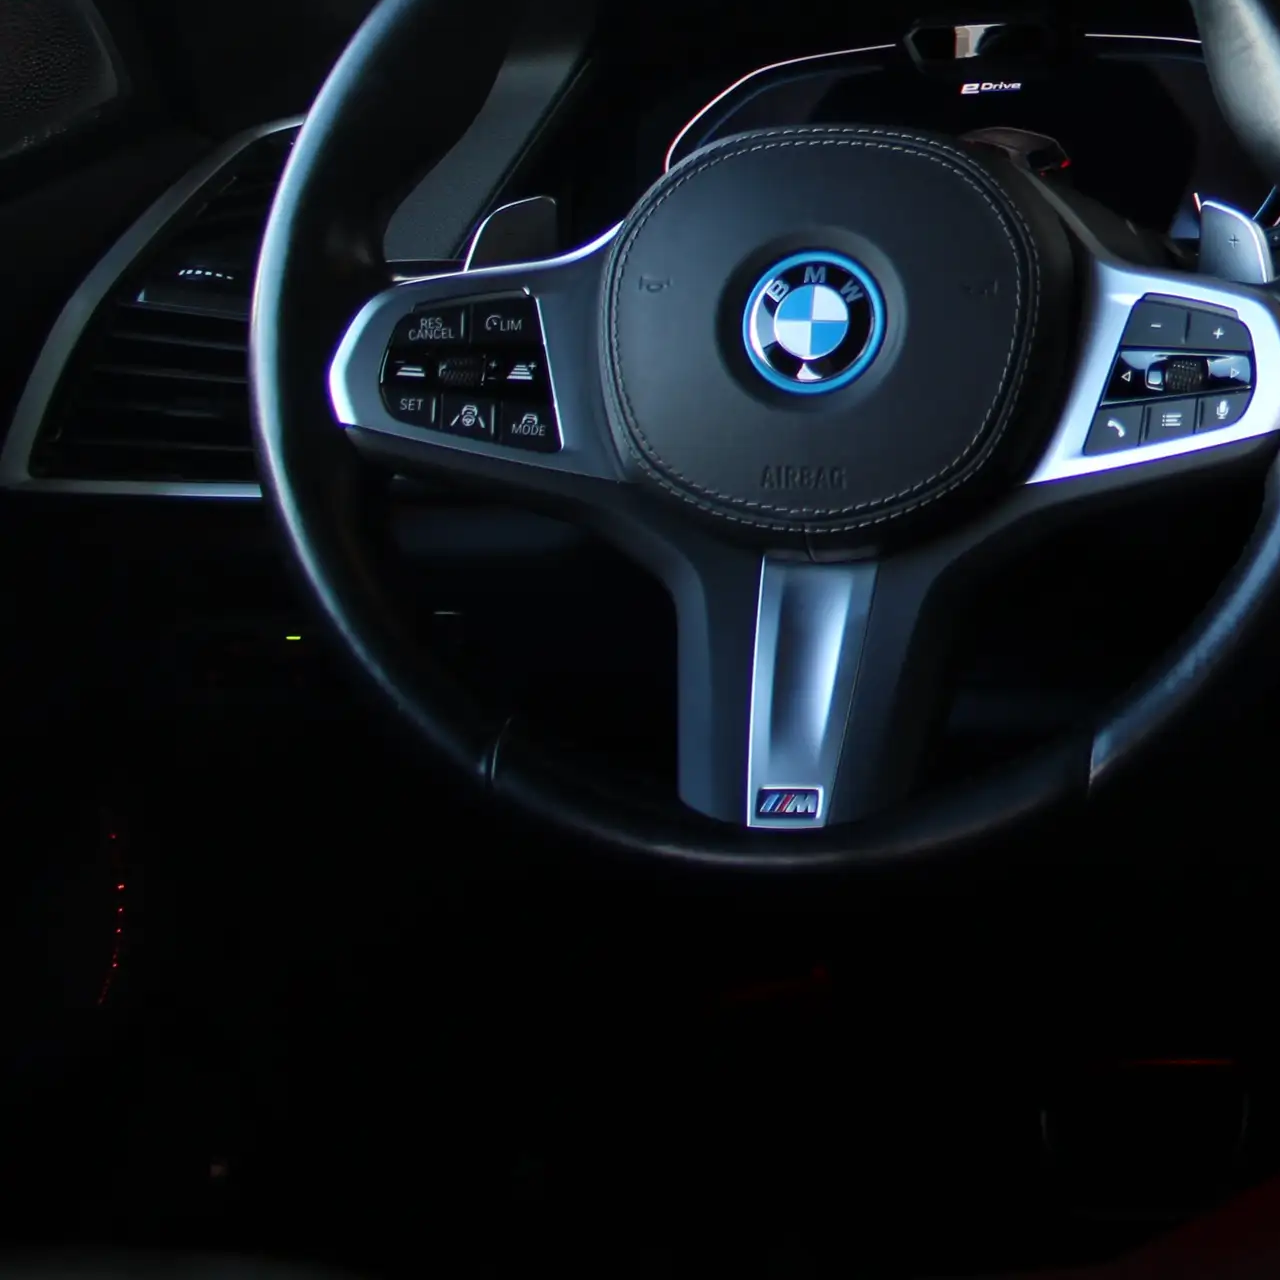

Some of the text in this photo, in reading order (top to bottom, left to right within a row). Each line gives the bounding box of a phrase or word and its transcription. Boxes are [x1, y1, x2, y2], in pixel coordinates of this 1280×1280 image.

[766, 266, 863, 302] BMW
[420, 318, 442, 330] RES
[500, 319, 522, 332] LIM
[408, 328, 454, 341] CANCEL
[400, 399, 424, 411] SET
[511, 424, 545, 436] MODE
[760, 464, 848, 490] AIRBAG
